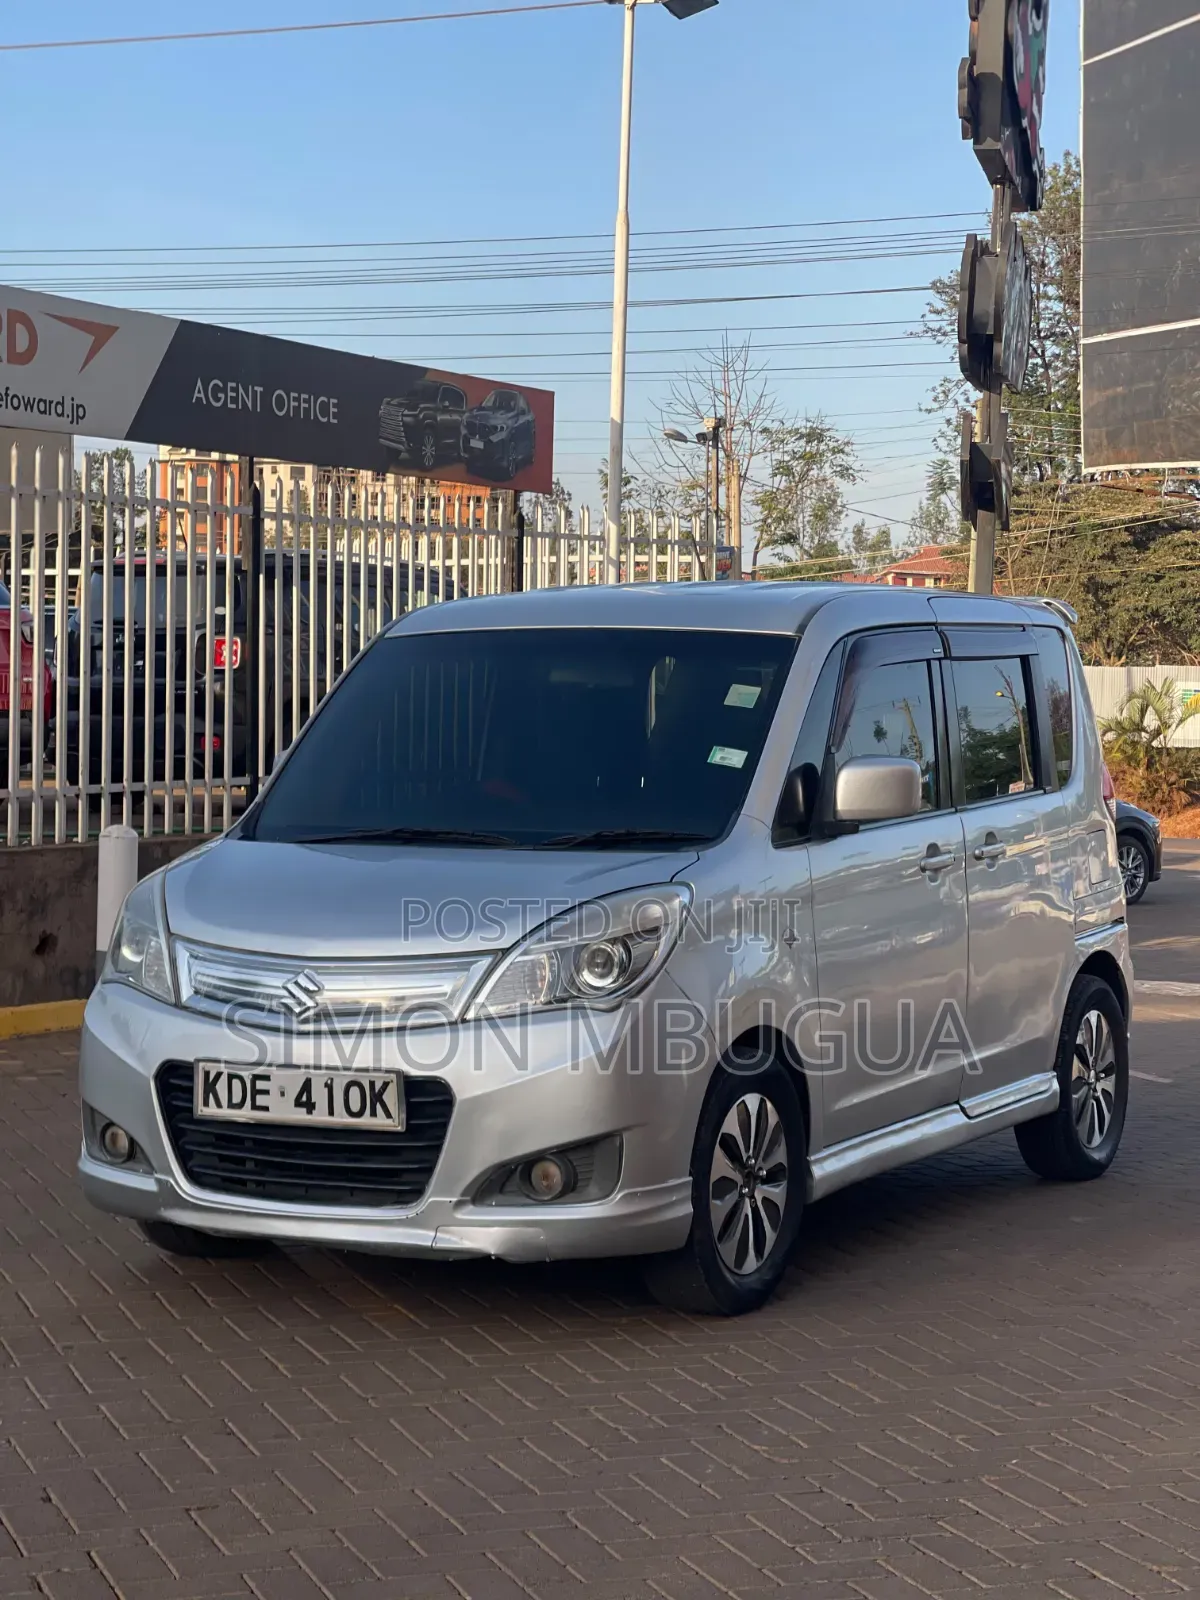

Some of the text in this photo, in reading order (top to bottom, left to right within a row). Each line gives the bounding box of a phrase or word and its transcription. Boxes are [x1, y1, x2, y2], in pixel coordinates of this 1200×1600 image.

[0, 309, 39, 366] D
[192, 377, 338, 424] AGENT OFFICE
[202, 1070, 394, 1120] KDE 410K
